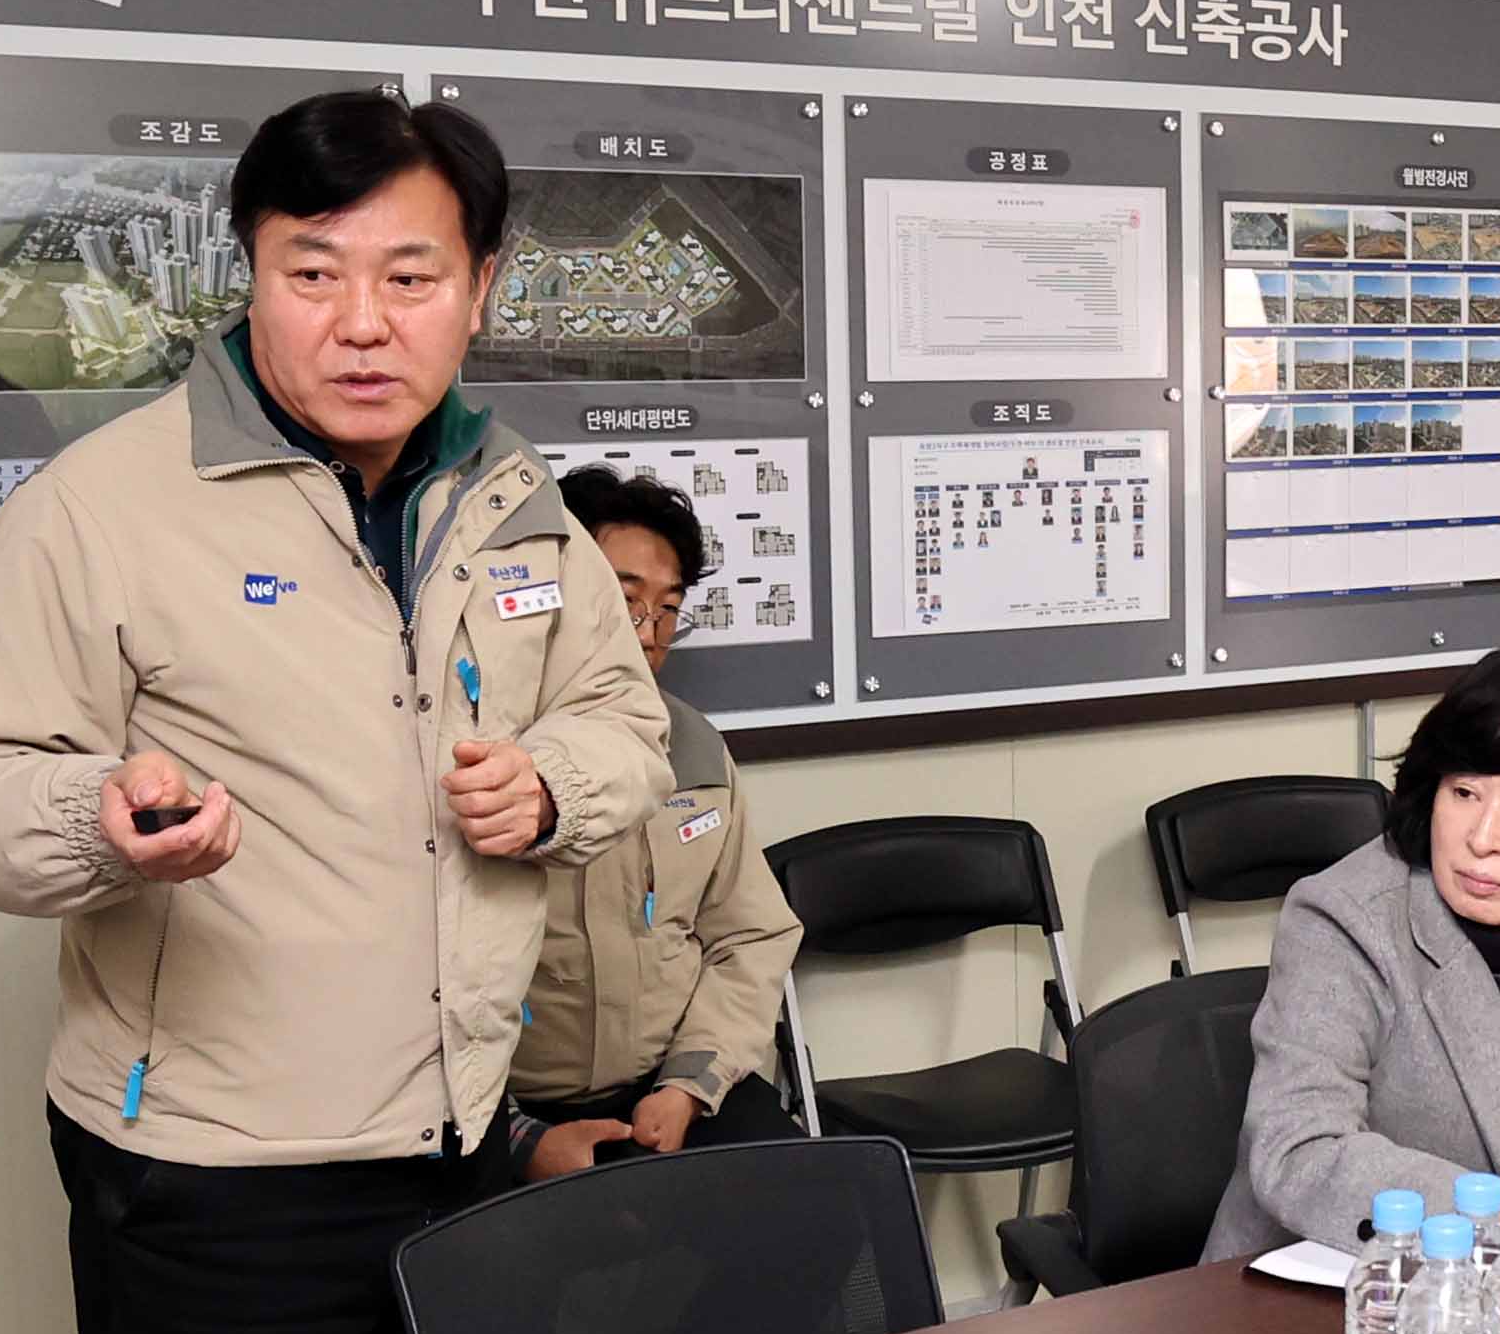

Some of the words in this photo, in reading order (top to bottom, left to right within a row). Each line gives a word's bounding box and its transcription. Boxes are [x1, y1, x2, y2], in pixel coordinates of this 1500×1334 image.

[139, 120, 222, 144] 조감도
[599, 135, 669, 158] 배치도
[988, 150, 1050, 173] 공정표
[1402, 167, 1469, 188] 월별전경사진
[586, 409, 692, 432] 단위세대평면도
[992, 403, 1053, 424] 조직도
[245, 578, 298, 599] We've
